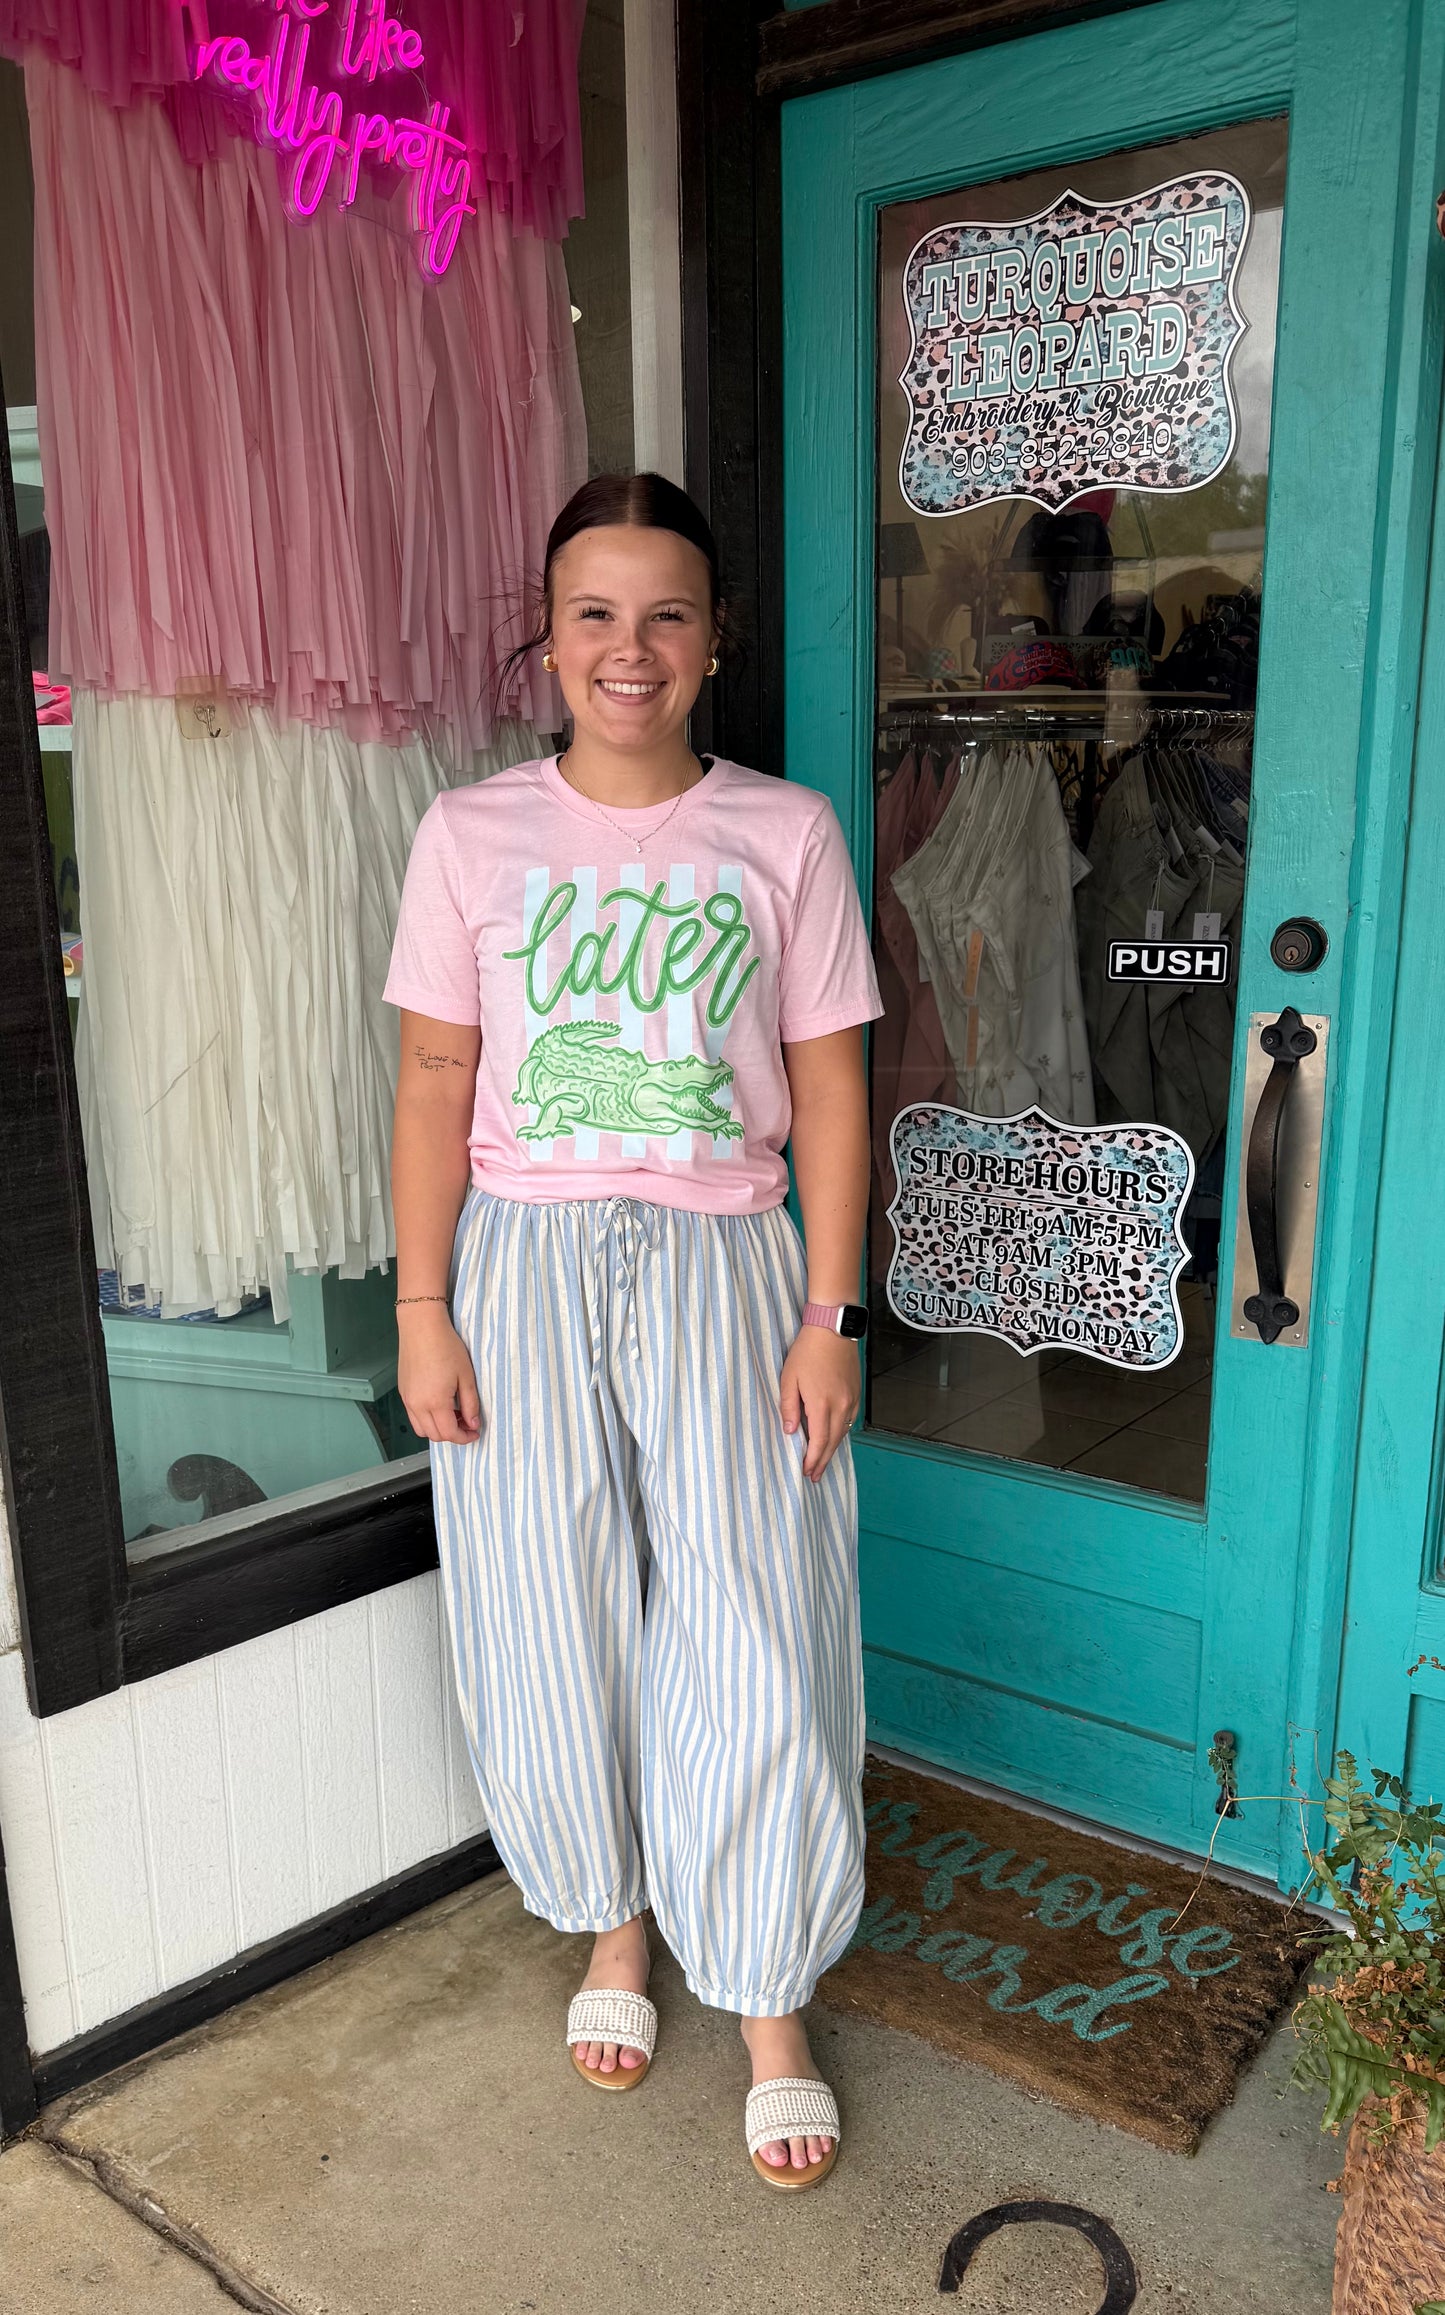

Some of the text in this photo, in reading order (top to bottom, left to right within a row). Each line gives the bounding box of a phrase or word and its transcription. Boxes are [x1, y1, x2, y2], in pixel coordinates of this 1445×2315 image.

[195, 13, 477, 275] really pretty
[922, 207, 1228, 329] TURQUOISE
[945, 302, 1189, 404] LEOPARD
[921, 376, 1213, 445] Embroidery & Boutique
[951, 421, 1174, 479] 903-852-2840
[501, 880, 761, 1028] later
[1115, 949, 1220, 976] PUSH
[909, 1147, 1168, 1205] STORE HOURS
[909, 1194, 1163, 1249] TUES-FRI 9AM-5PM
[942, 1232, 1121, 1279] SAT 9AM-3PM
[974, 1270, 1082, 1306] CLOSED
[905, 1291, 1160, 1354] SUNDAY & MONDAY
